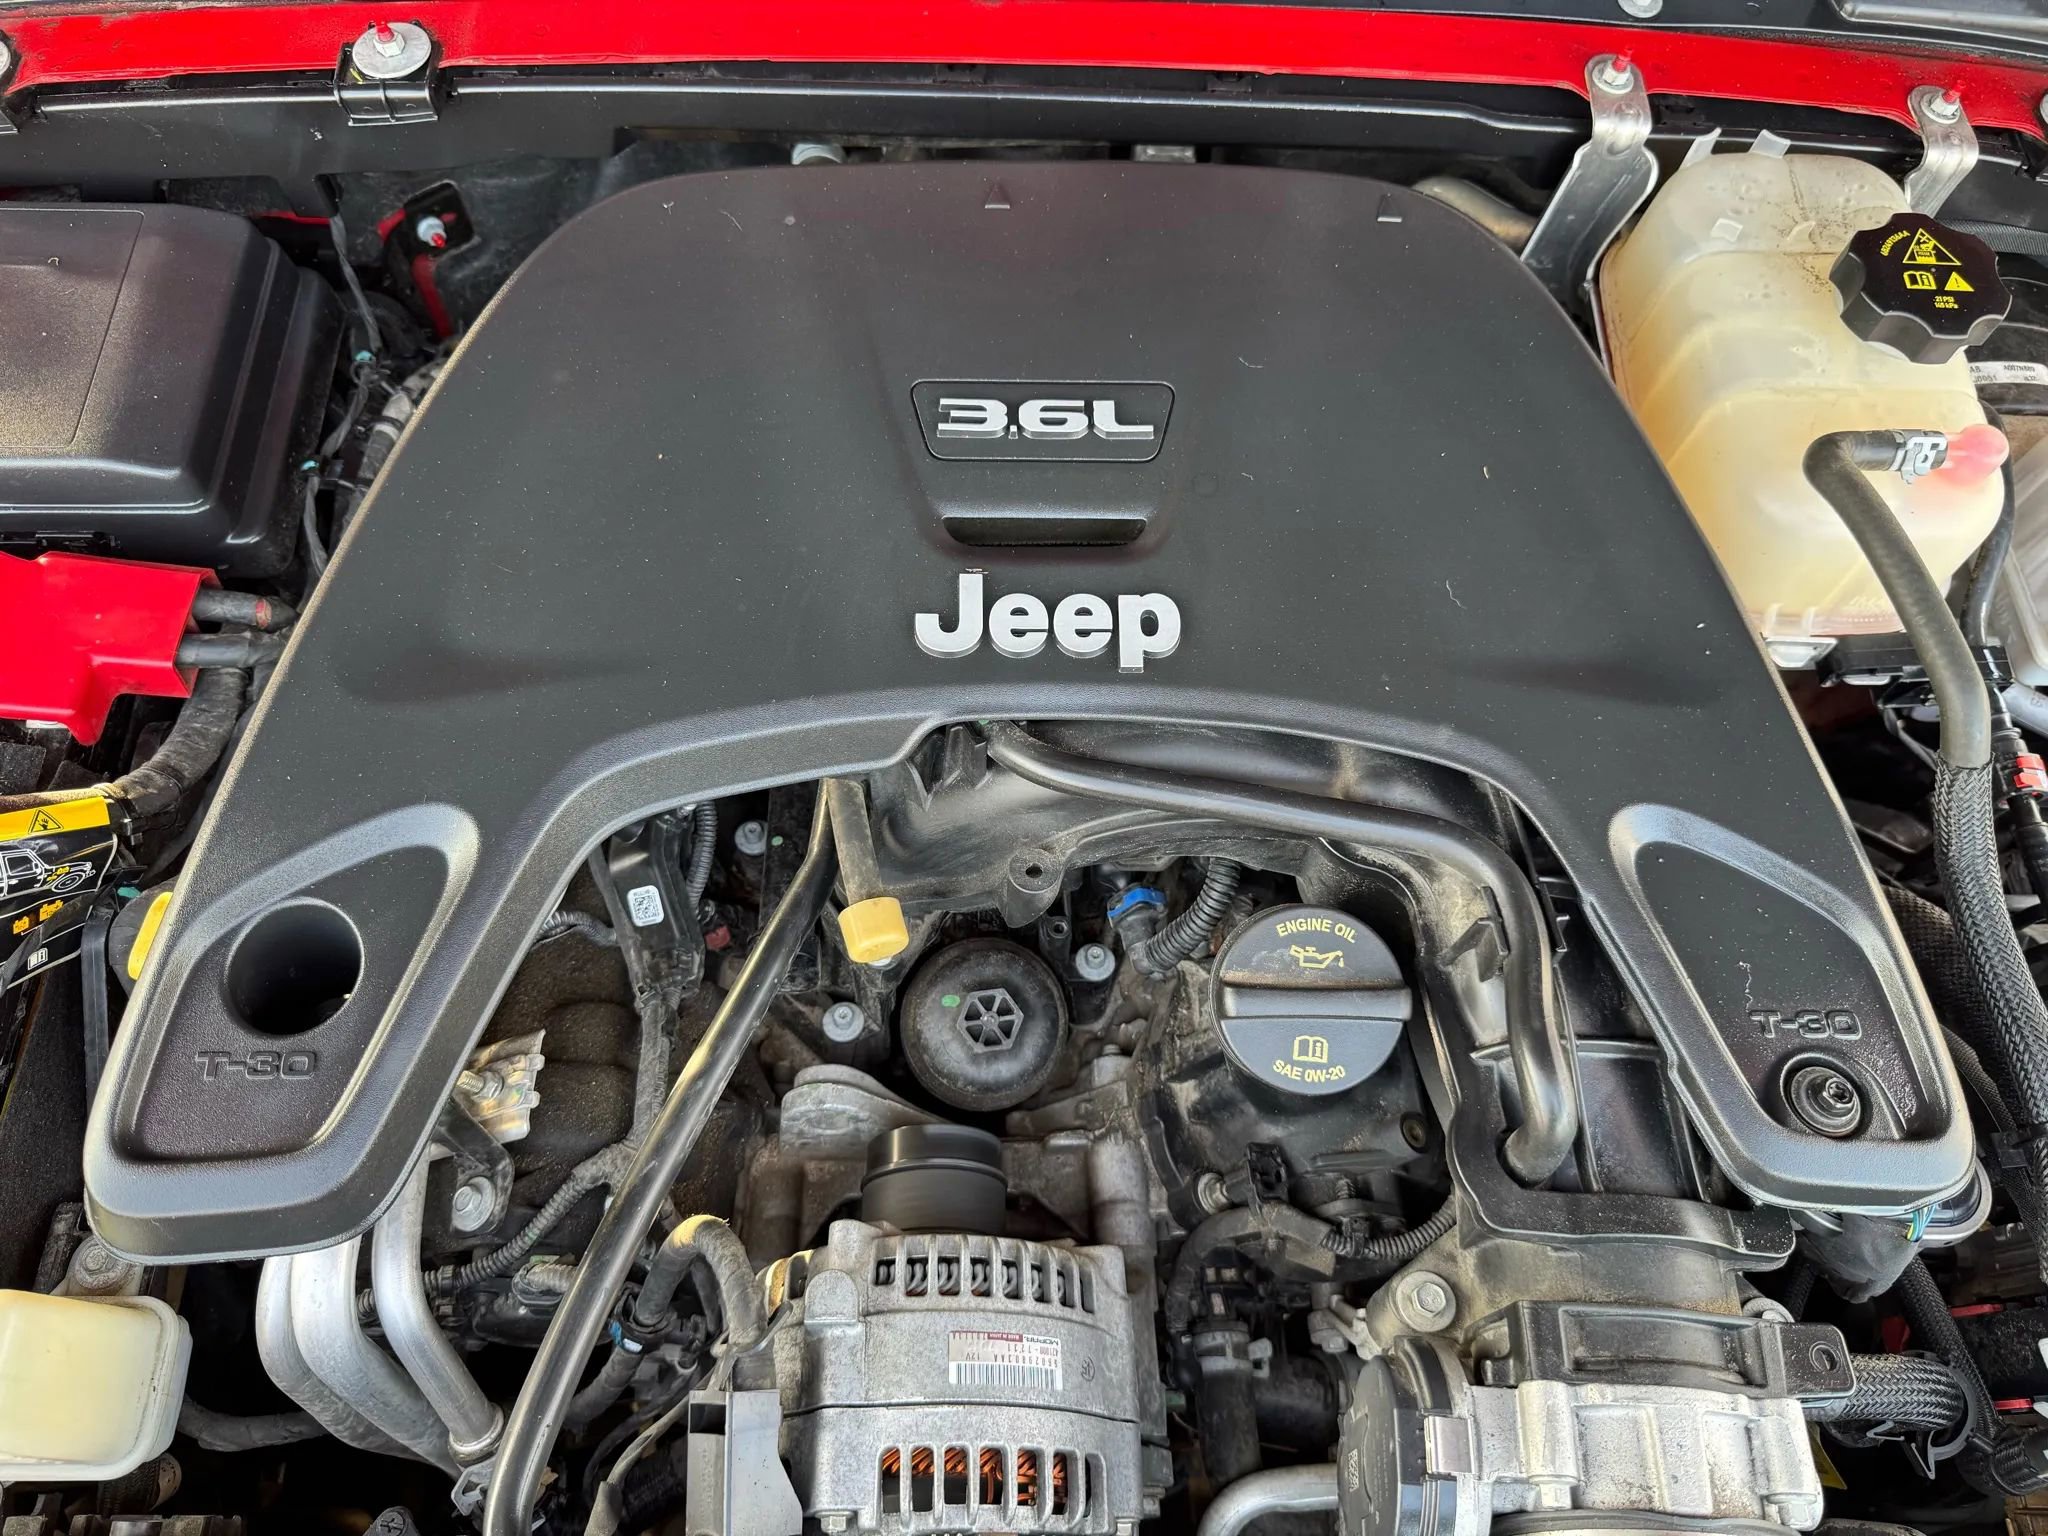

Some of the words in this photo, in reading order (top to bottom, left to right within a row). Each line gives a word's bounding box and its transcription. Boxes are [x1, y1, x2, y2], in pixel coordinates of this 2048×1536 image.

[937, 398, 1154, 439] 3.6L
[914, 573, 1181, 673] Jeep
[1275, 918, 1333, 937] ENGINE
[1334, 923, 1359, 944] OIL
[1749, 1009, 1862, 1040] T-30
[195, 1051, 317, 1080] T-30
[1272, 1059, 1302, 1081] SAE
[1304, 1065, 1346, 1082] 0W-20
[964, 1351, 980, 1361] 12V
